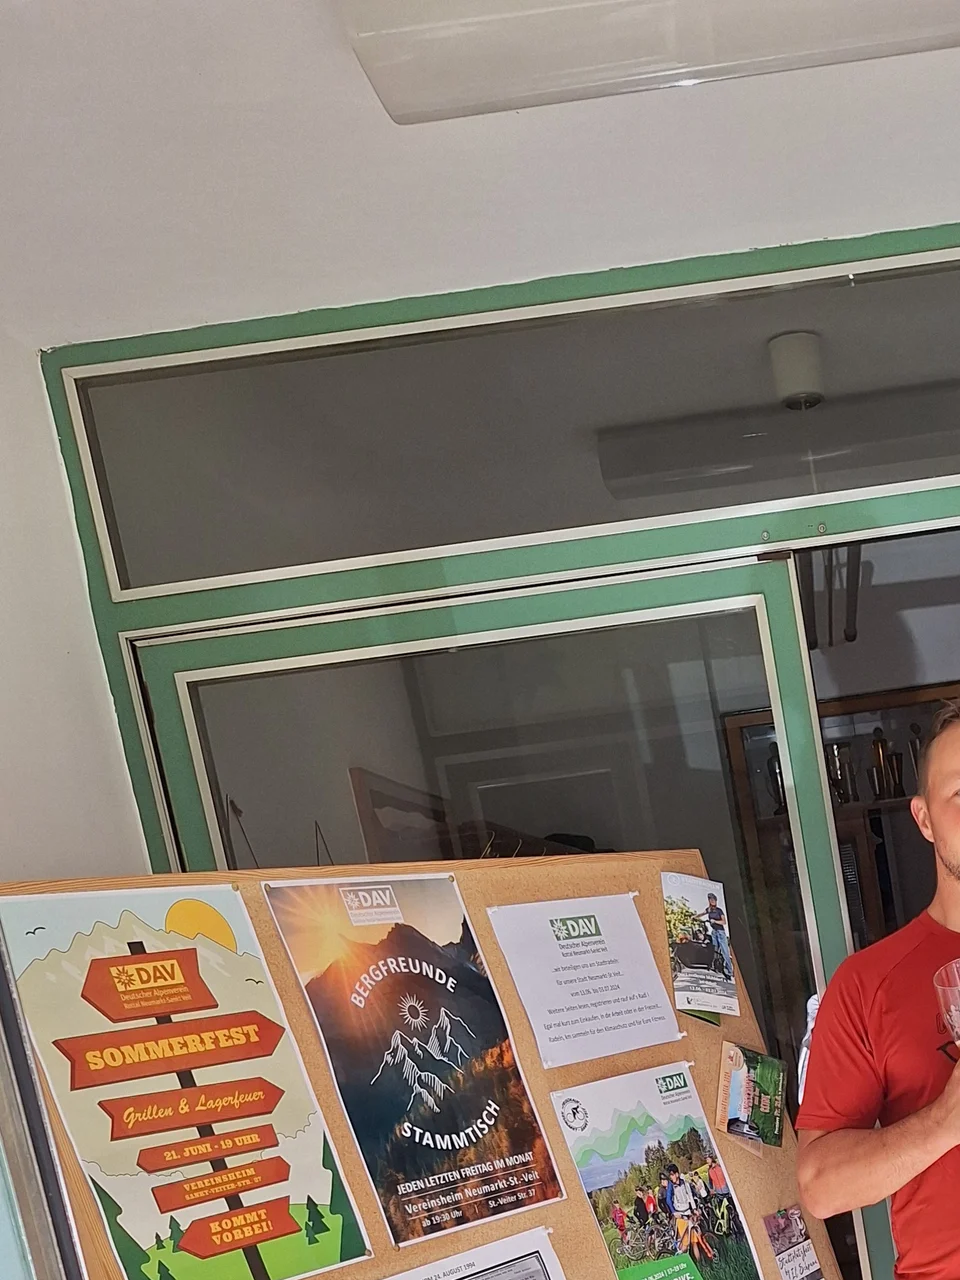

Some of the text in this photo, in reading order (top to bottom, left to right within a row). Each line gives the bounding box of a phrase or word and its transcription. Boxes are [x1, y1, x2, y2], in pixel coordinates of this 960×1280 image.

[357, 889, 391, 906] DAV
[566, 917, 596, 936] DAV
[134, 963, 176, 984] DAV
[351, 957, 457, 1008] BERGFREUNDE
[119, 984, 189, 1001] Deutscher Alpenverein
[86, 1025, 258, 1069] SOMMERFEST
[665, 1074, 685, 1089] DAV
[122, 1090, 264, 1129] Grillen & Lagerfeuer
[401, 1100, 500, 1150] STAMMTISCH
[163, 1149, 181, 1161] 21.
[183, 1142, 212, 1157] JUNI
[219, 1138, 233, 1149] 19
[233, 1133, 260, 1146] UHR
[183, 1167, 255, 1191] VEREINSHEIM
[396, 1151, 534, 1195] JEDEN LETZTEN FREITAG IM MONAT
[404, 1170, 539, 1214] Vereinsheim Neumarkt-St.-Veit
[421, 1217, 431, 1227] ab
[431, 1212, 450, 1224] 19:30
[449, 1209, 463, 1219] Uhr
[516, 1191, 528, 1200] Str.
[527, 1188, 536, 1197] 37
[209, 1208, 267, 1233] KOMMT
[211, 1220, 273, 1245] VORBEI!
[433, 1273, 442, 1280] 24.
[442, 1265, 463, 1278] AUGUST
[462, 1261, 476, 1270] 1994
[678, 1262, 687, 1270] Uhr
